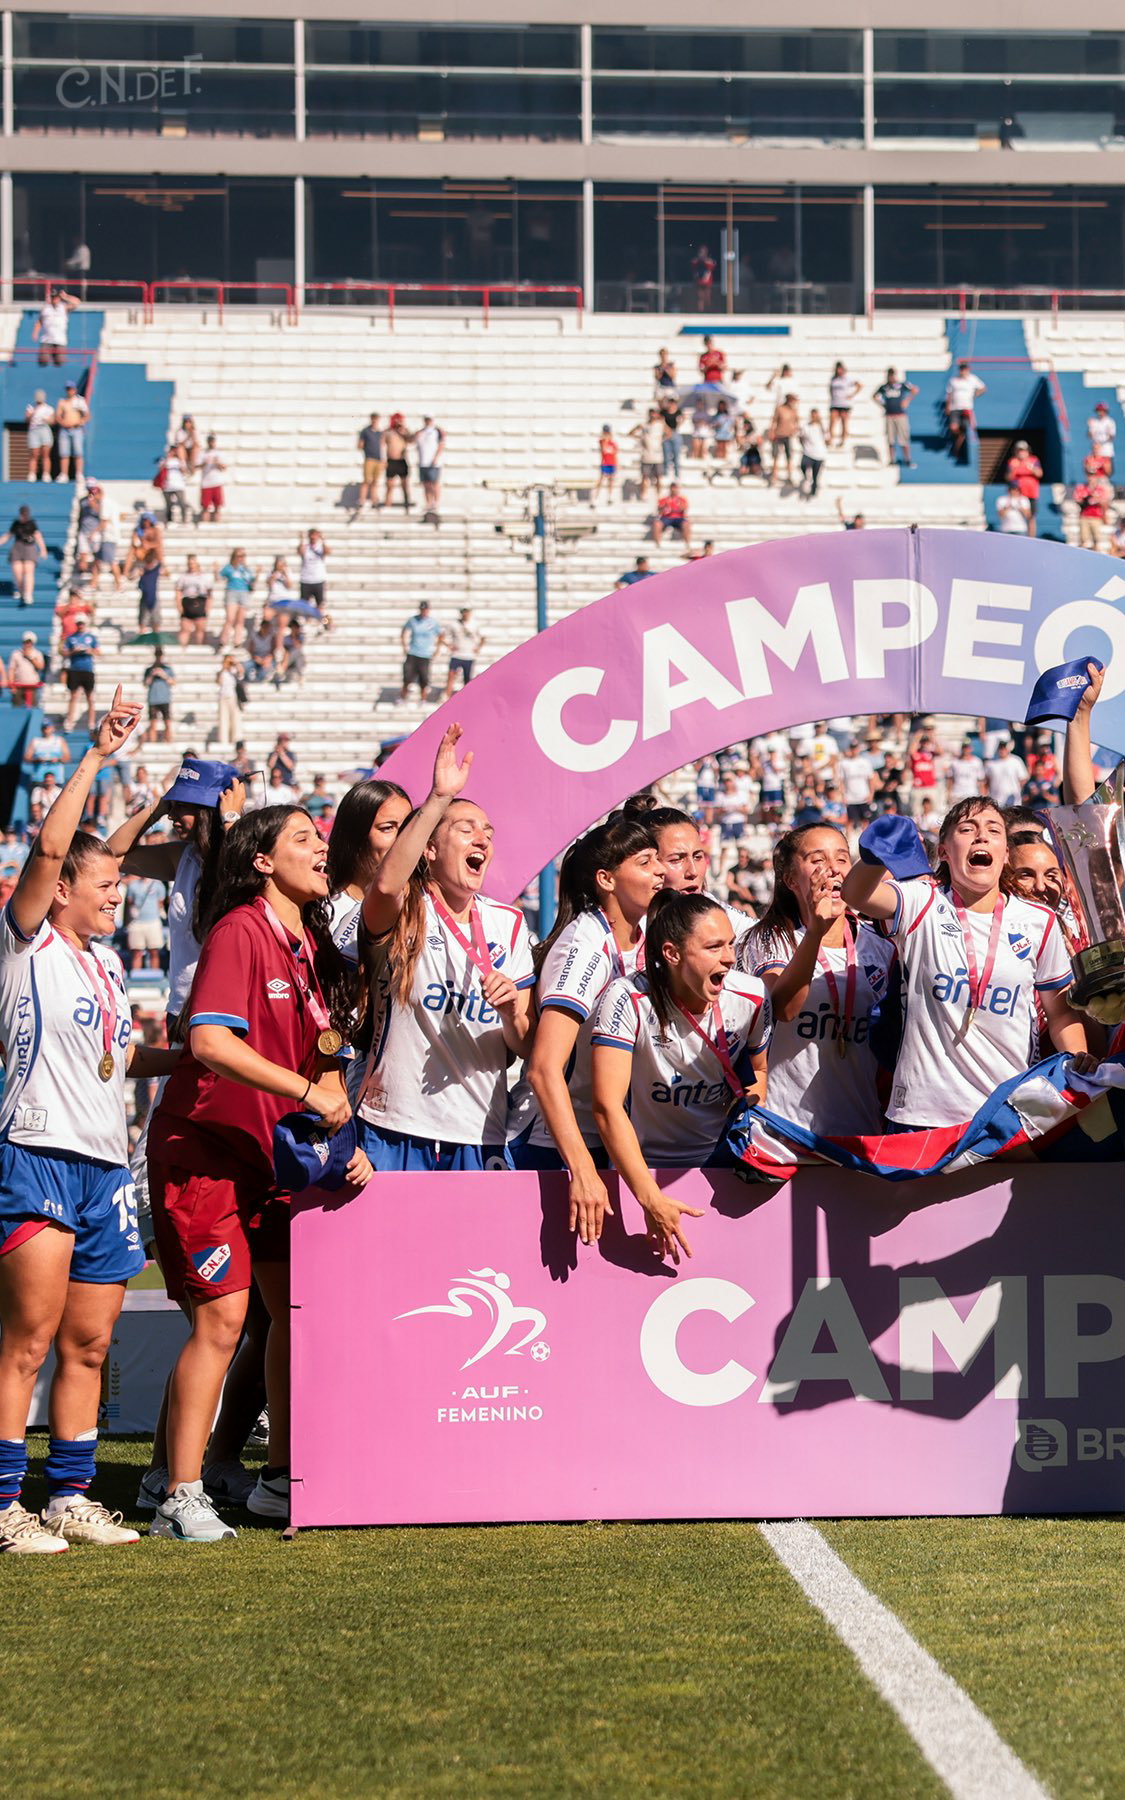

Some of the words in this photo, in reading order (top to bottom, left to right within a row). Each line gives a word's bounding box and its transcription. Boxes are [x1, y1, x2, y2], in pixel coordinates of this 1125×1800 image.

[555, 947, 578, 991] SARUBBI
[577, 951, 602, 997] SARUBBI
[437, 1406, 543, 1423] FEMENINO
